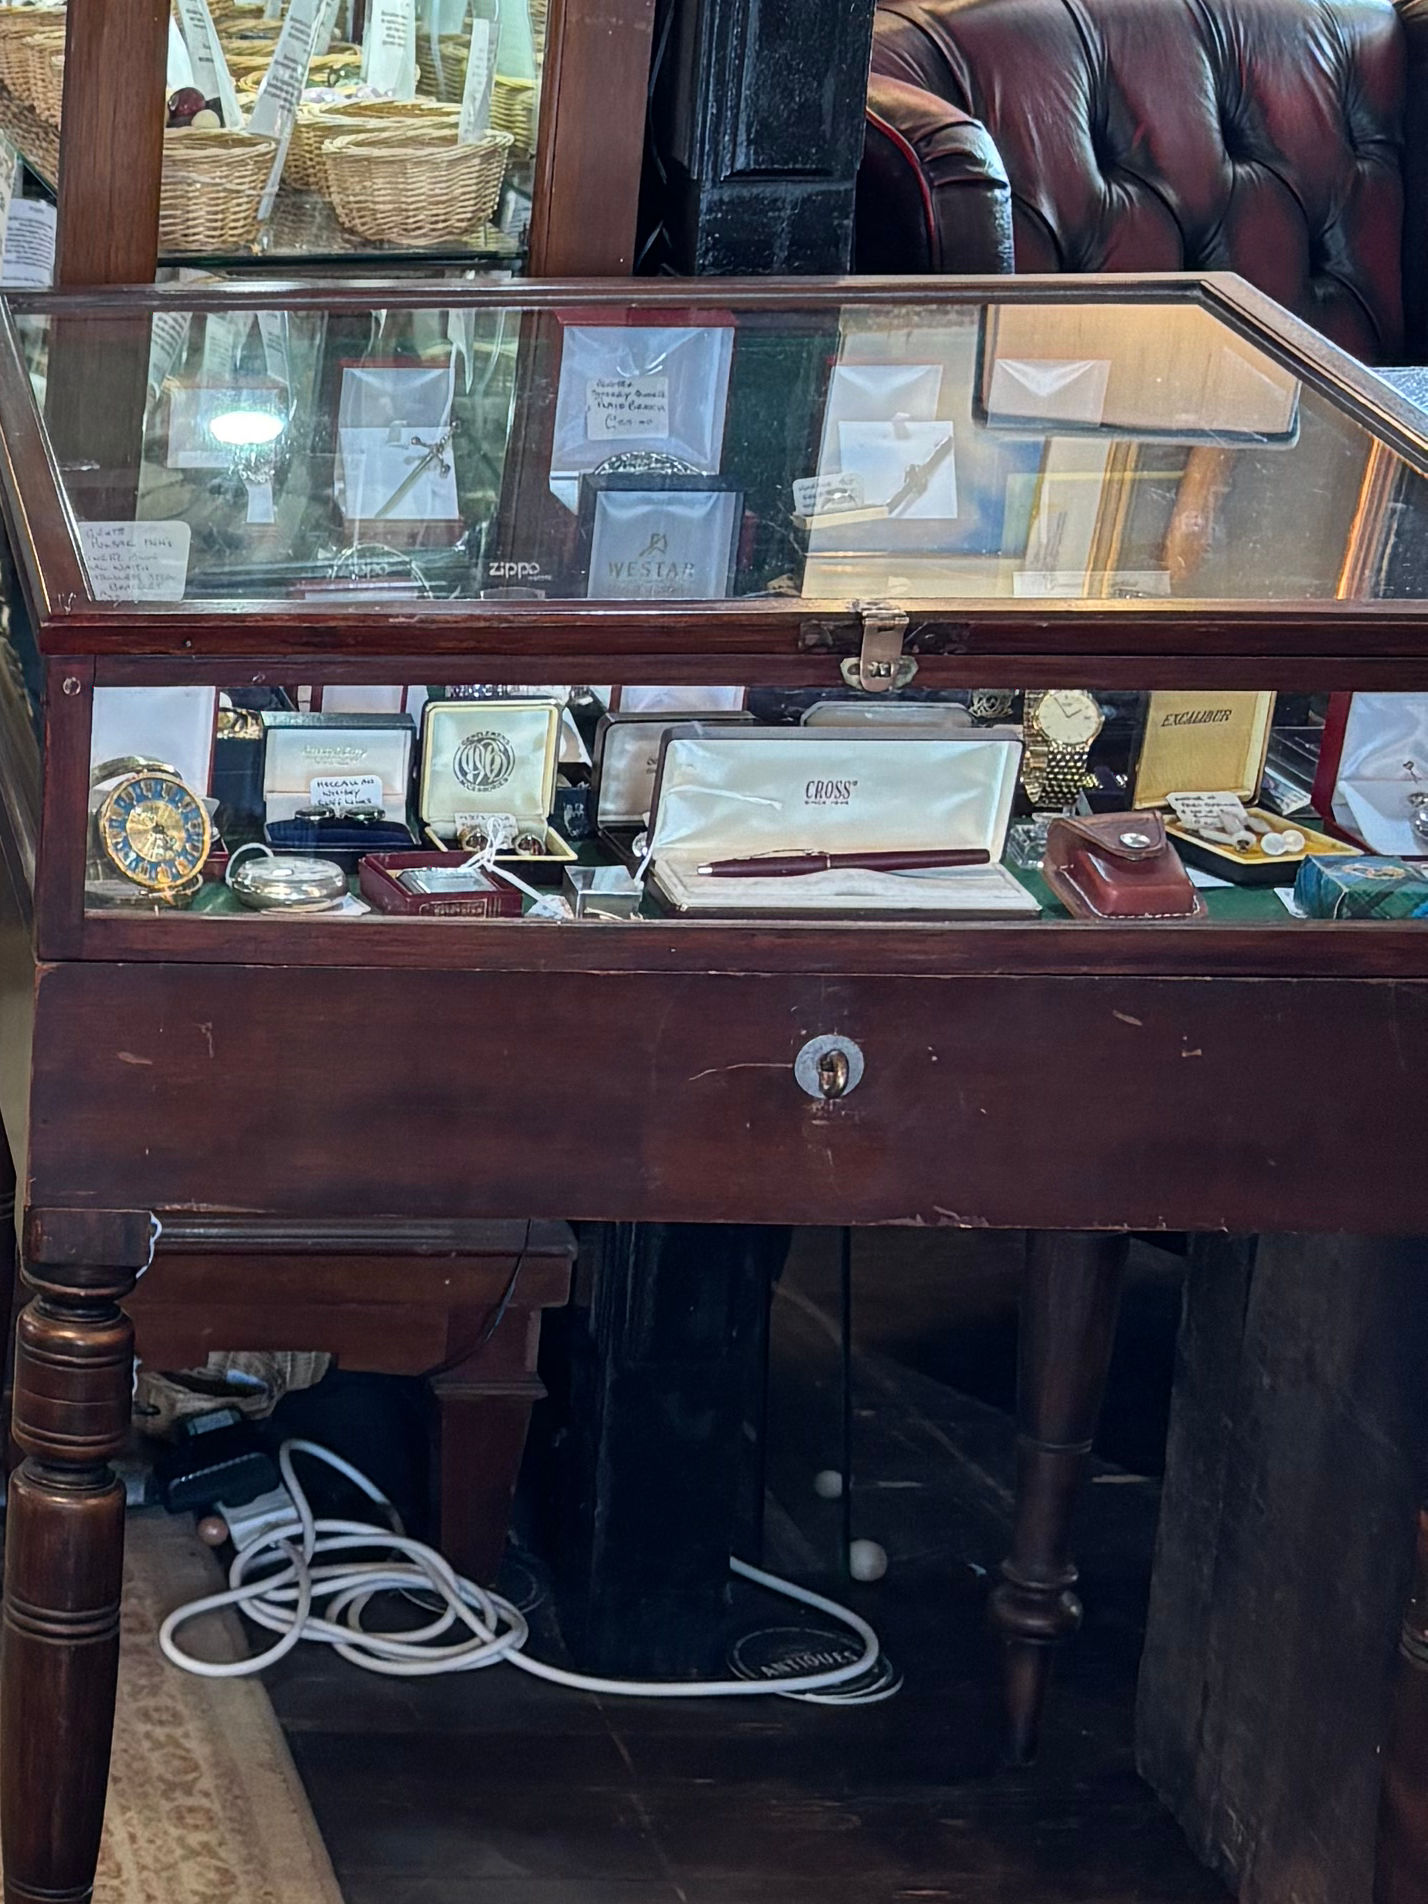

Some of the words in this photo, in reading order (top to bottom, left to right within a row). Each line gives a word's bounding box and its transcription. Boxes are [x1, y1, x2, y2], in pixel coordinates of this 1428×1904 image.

[488, 561, 540, 579] zippo
[608, 561, 696, 579] WESTAR
[1160, 709, 1232, 727] EXCALIBUR
[805, 780, 852, 800] CROSS
[759, 1649, 860, 1678] ANTIQUES
